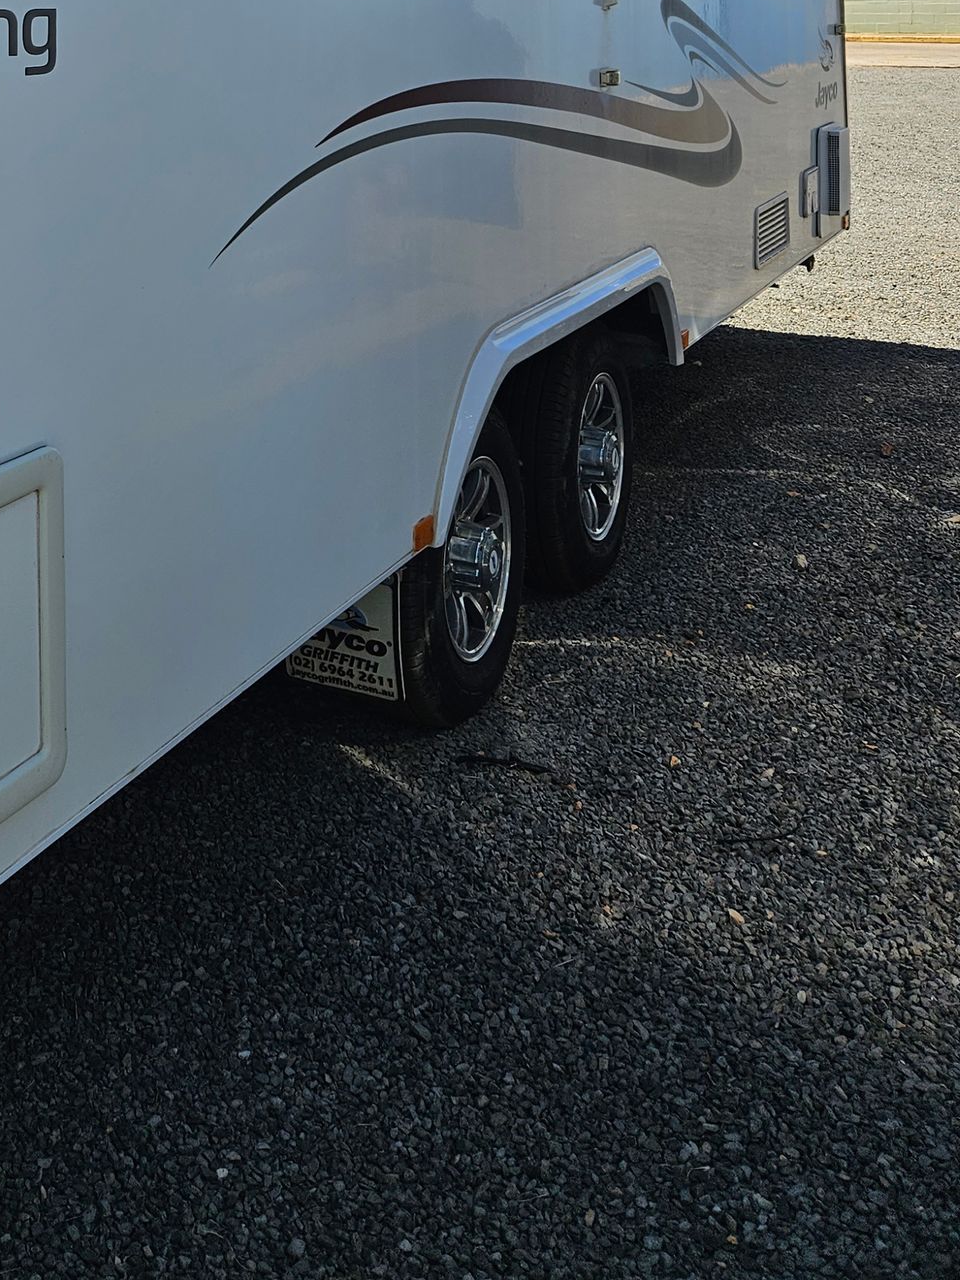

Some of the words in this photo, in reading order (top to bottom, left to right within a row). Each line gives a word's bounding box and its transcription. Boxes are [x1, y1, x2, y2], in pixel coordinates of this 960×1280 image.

[814, 81, 838, 110] Jayco
[289, 653, 315, 672] (02)
[319, 662, 355, 680] 6964
[358, 670, 394, 689] 2611
[300, 644, 379, 674] GRIFFITH
